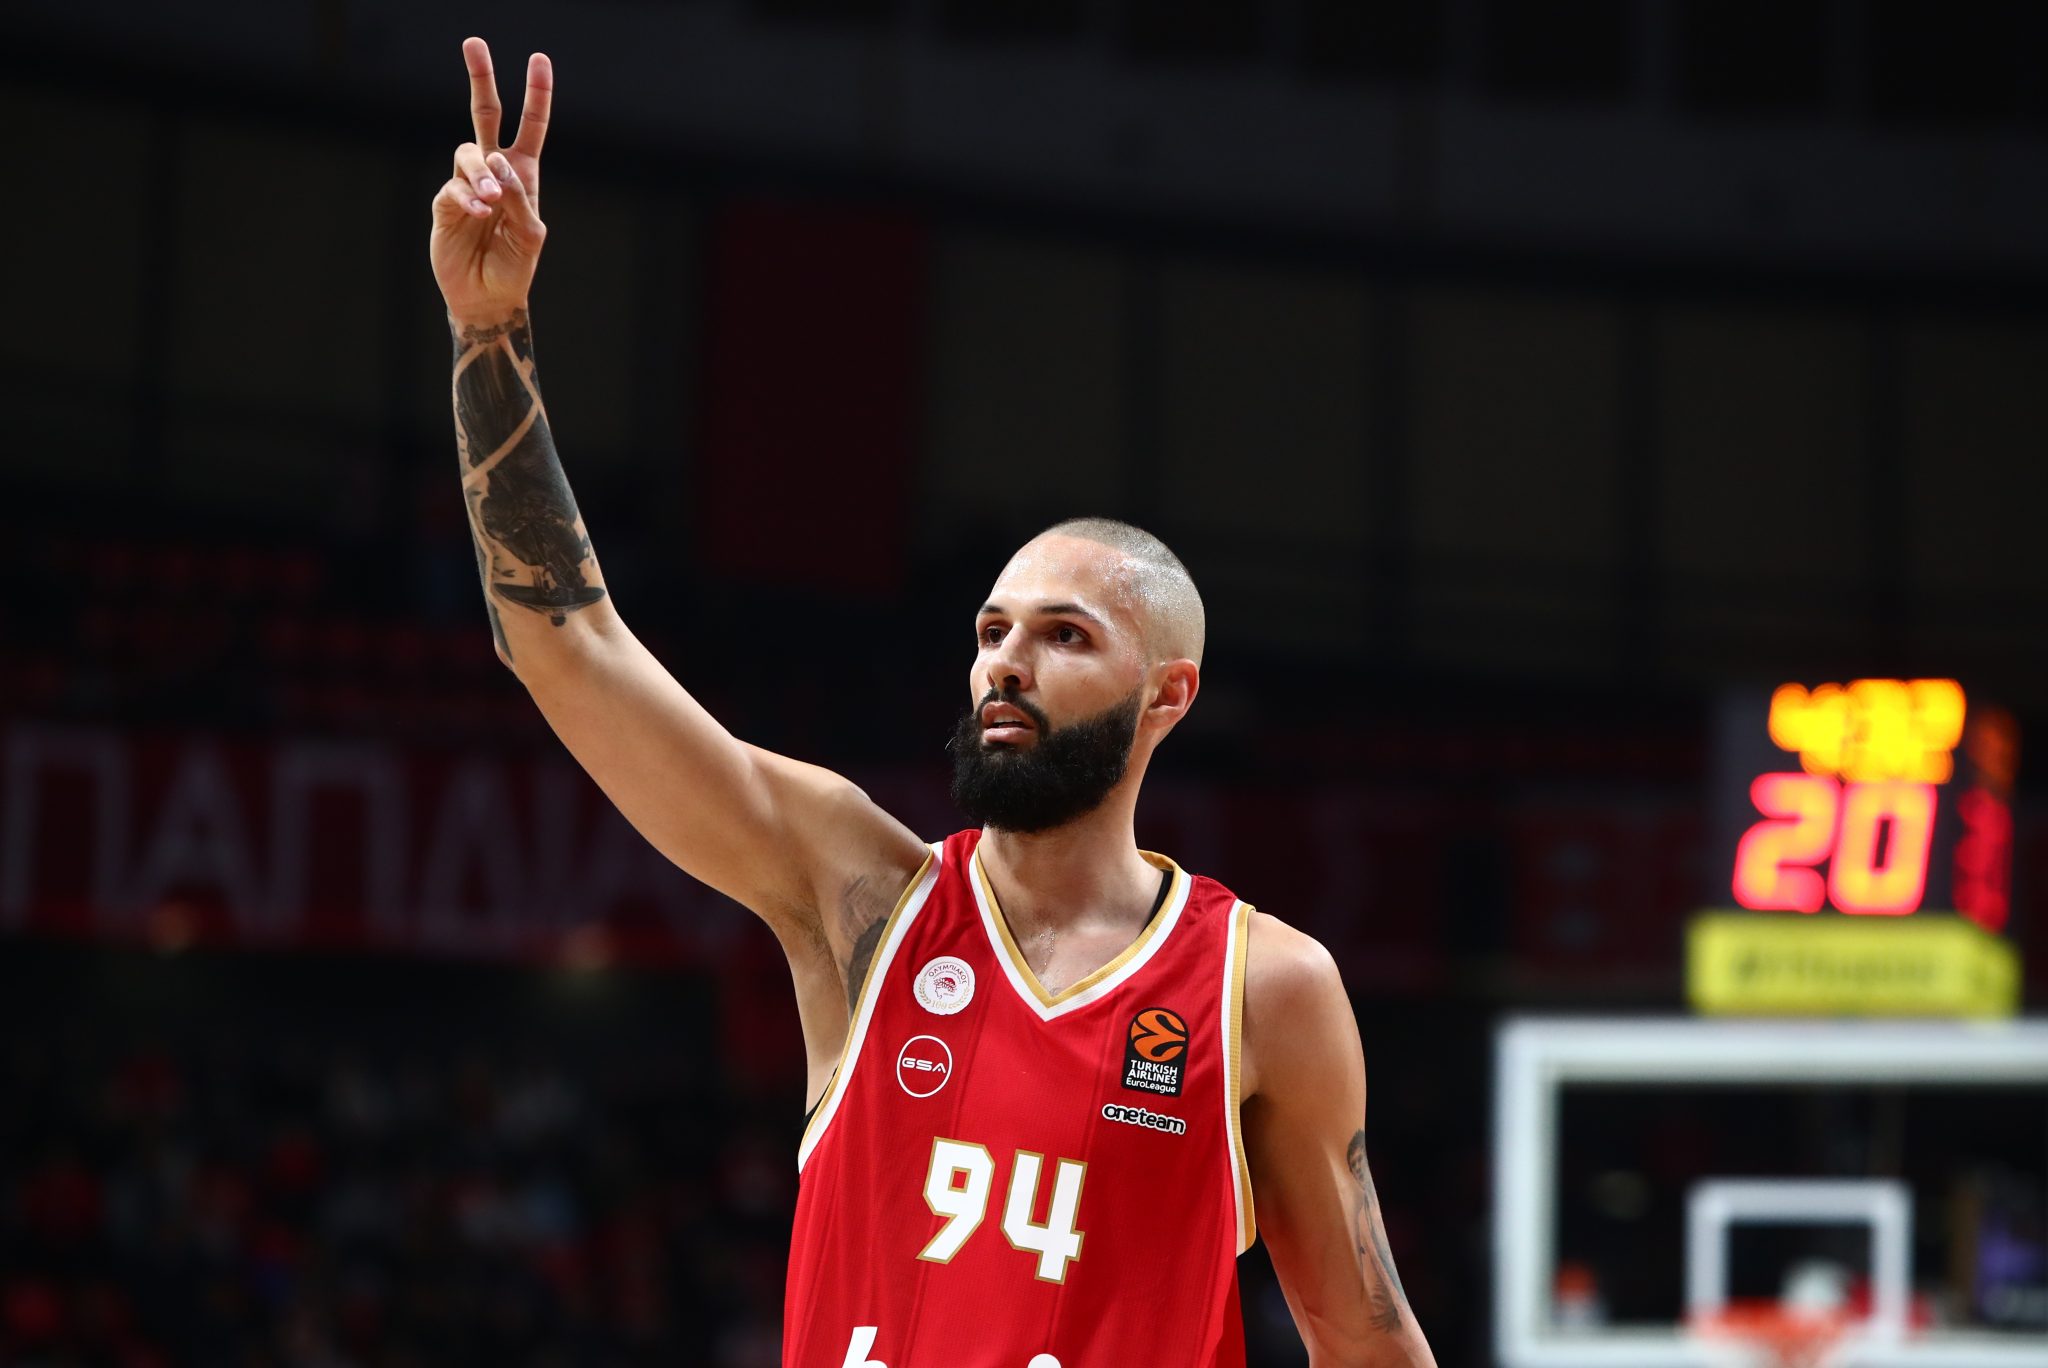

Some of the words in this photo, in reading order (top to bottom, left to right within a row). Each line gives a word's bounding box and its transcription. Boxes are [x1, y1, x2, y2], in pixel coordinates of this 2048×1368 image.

[1732, 772, 1938, 915] 20
[901, 1057, 947, 1074] GSA
[1130, 1060, 1178, 1077] TURKISH
[1125, 1077, 1177, 1094] EuroLeague
[1127, 1069, 1177, 1085] AIRLINES
[1102, 1104, 1186, 1135] oneteam
[916, 1136, 1088, 1285] 94
